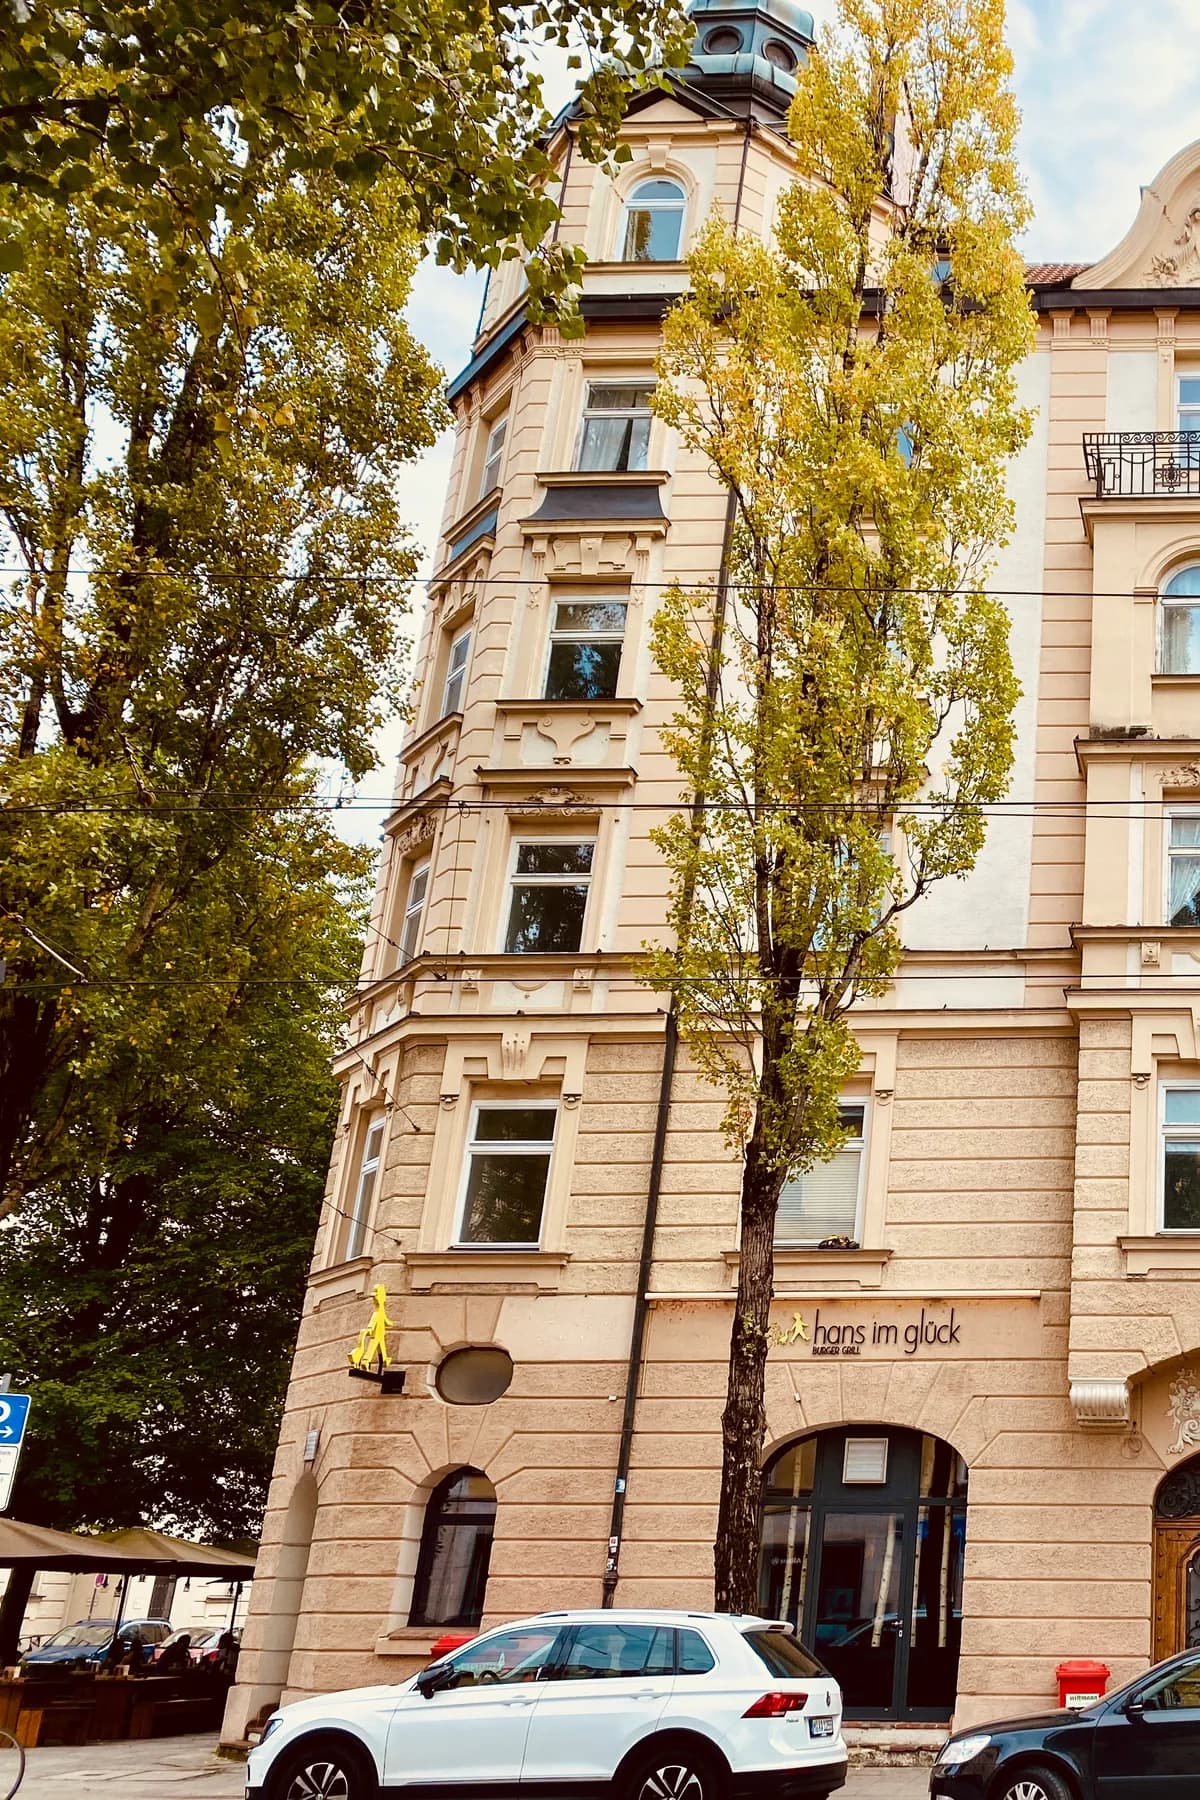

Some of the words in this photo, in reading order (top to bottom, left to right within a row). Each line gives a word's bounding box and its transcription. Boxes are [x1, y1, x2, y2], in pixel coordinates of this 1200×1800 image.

[813, 1308, 866, 1344] hans
[872, 1321, 898, 1344] im
[904, 1307, 961, 1354] glück
[812, 1346, 840, 1355] BURGER
[841, 1346, 861, 1355] GRILL
